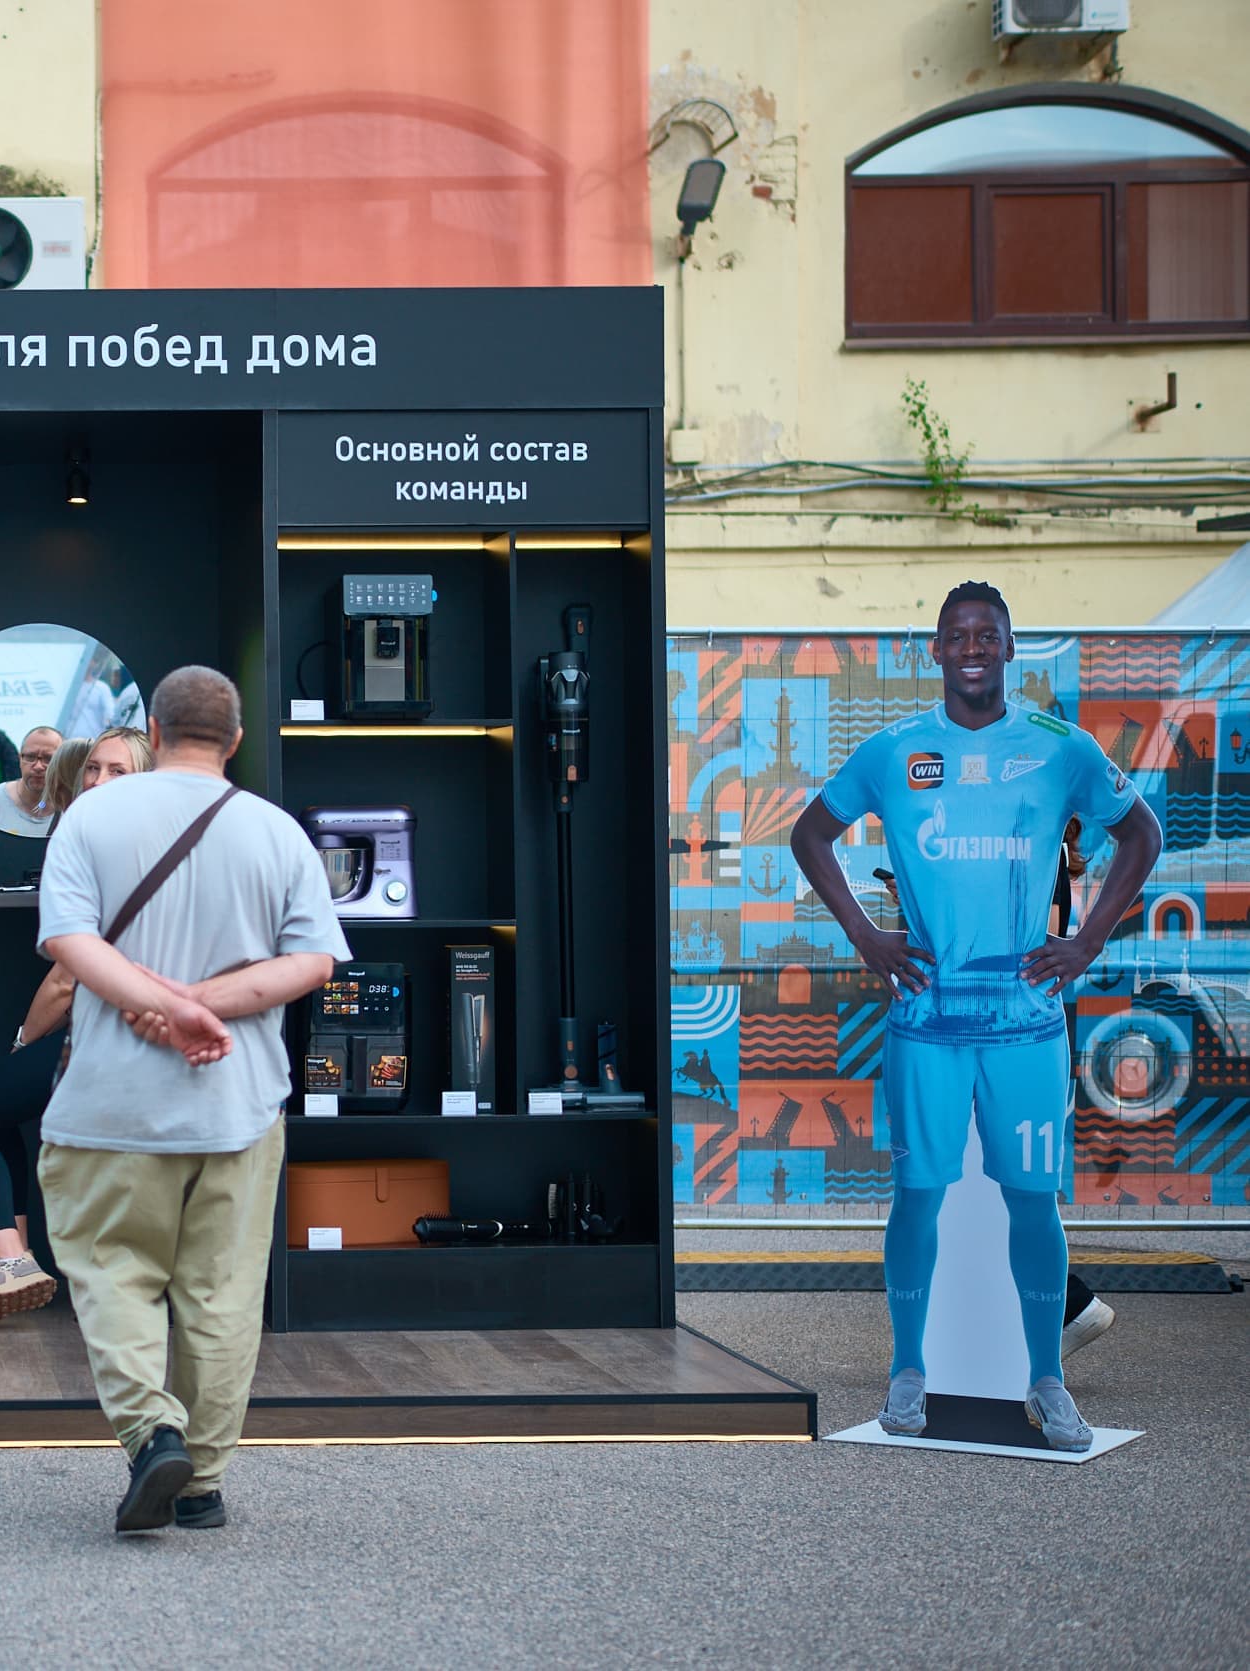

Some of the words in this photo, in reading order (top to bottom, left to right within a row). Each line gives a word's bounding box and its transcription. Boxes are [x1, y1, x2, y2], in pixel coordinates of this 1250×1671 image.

[68, 323, 228, 375] побед
[246, 334, 377, 374] дома
[335, 433, 479, 462] Основной
[489, 442, 588, 462] состав
[396, 481, 527, 504] команды
[915, 764, 942, 778] WIN
[945, 836, 1032, 861] ГАЗПРОМ
[1015, 1119, 1054, 1174] 11
